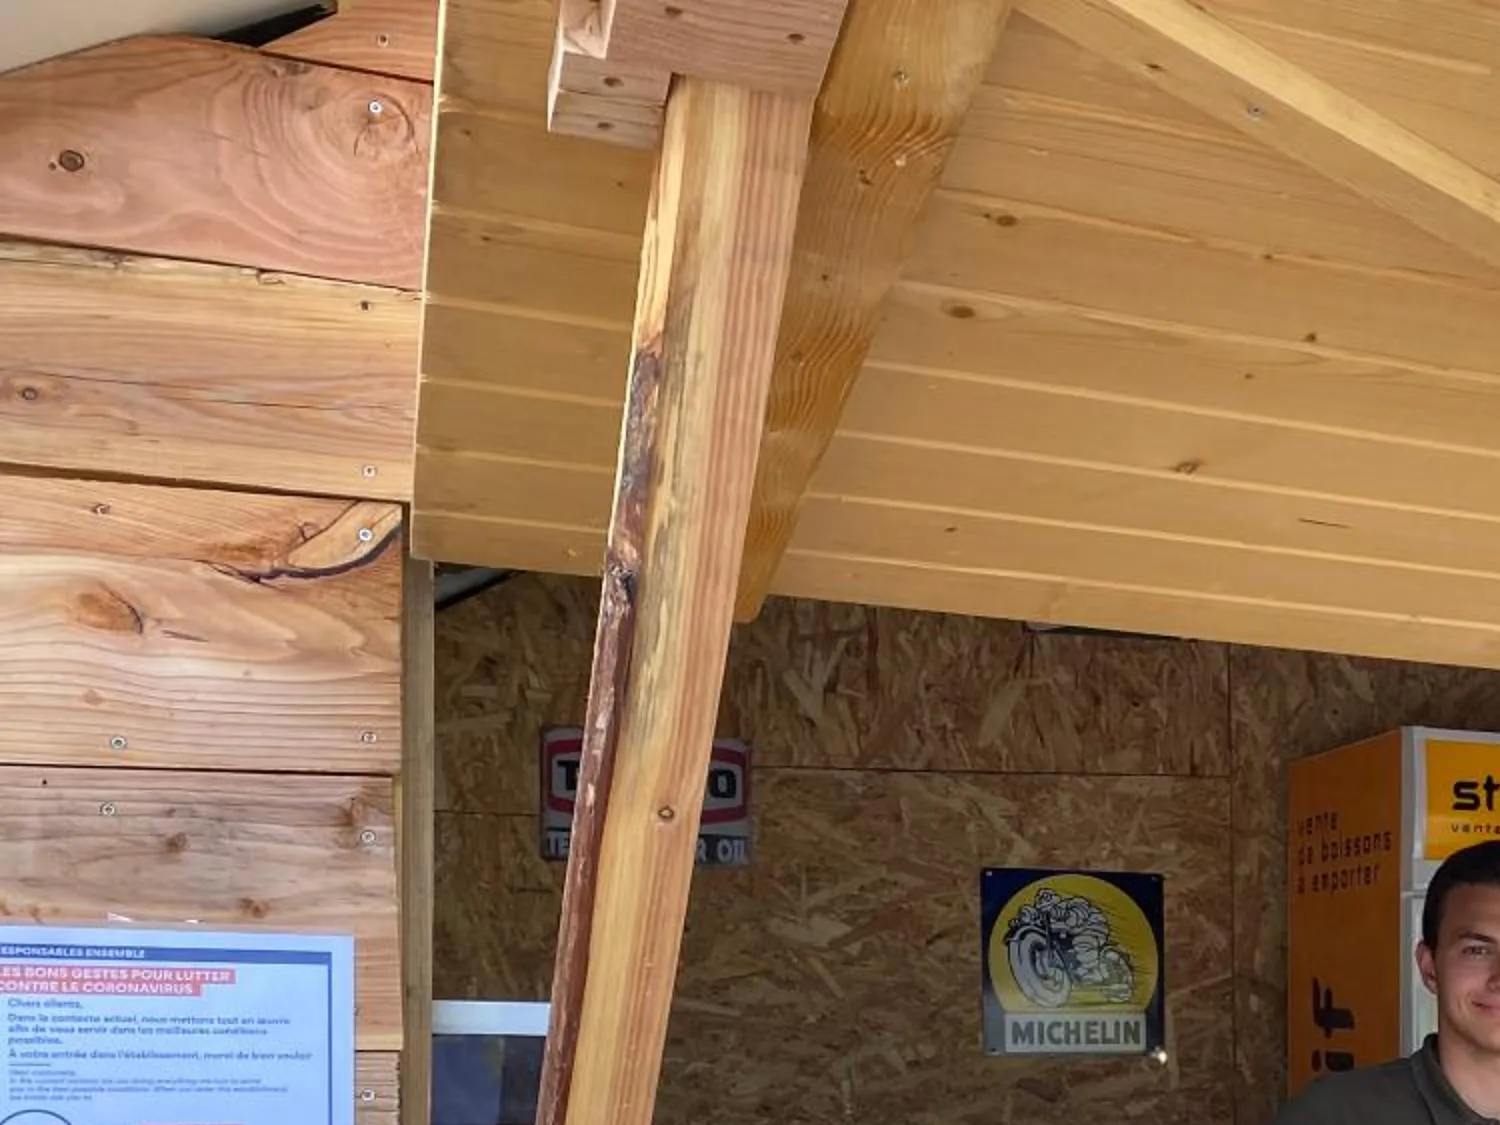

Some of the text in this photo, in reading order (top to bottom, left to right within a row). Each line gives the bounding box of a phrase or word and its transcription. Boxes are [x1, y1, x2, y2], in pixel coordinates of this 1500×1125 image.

[1322, 831, 1392, 862] boissons
[0, 946, 83, 957] ESPONSABLES
[131, 969, 173, 981] POUR
[83, 982, 193, 995] CORONAVIRUS
[1011, 1020, 1140, 1046] MICHELIN
